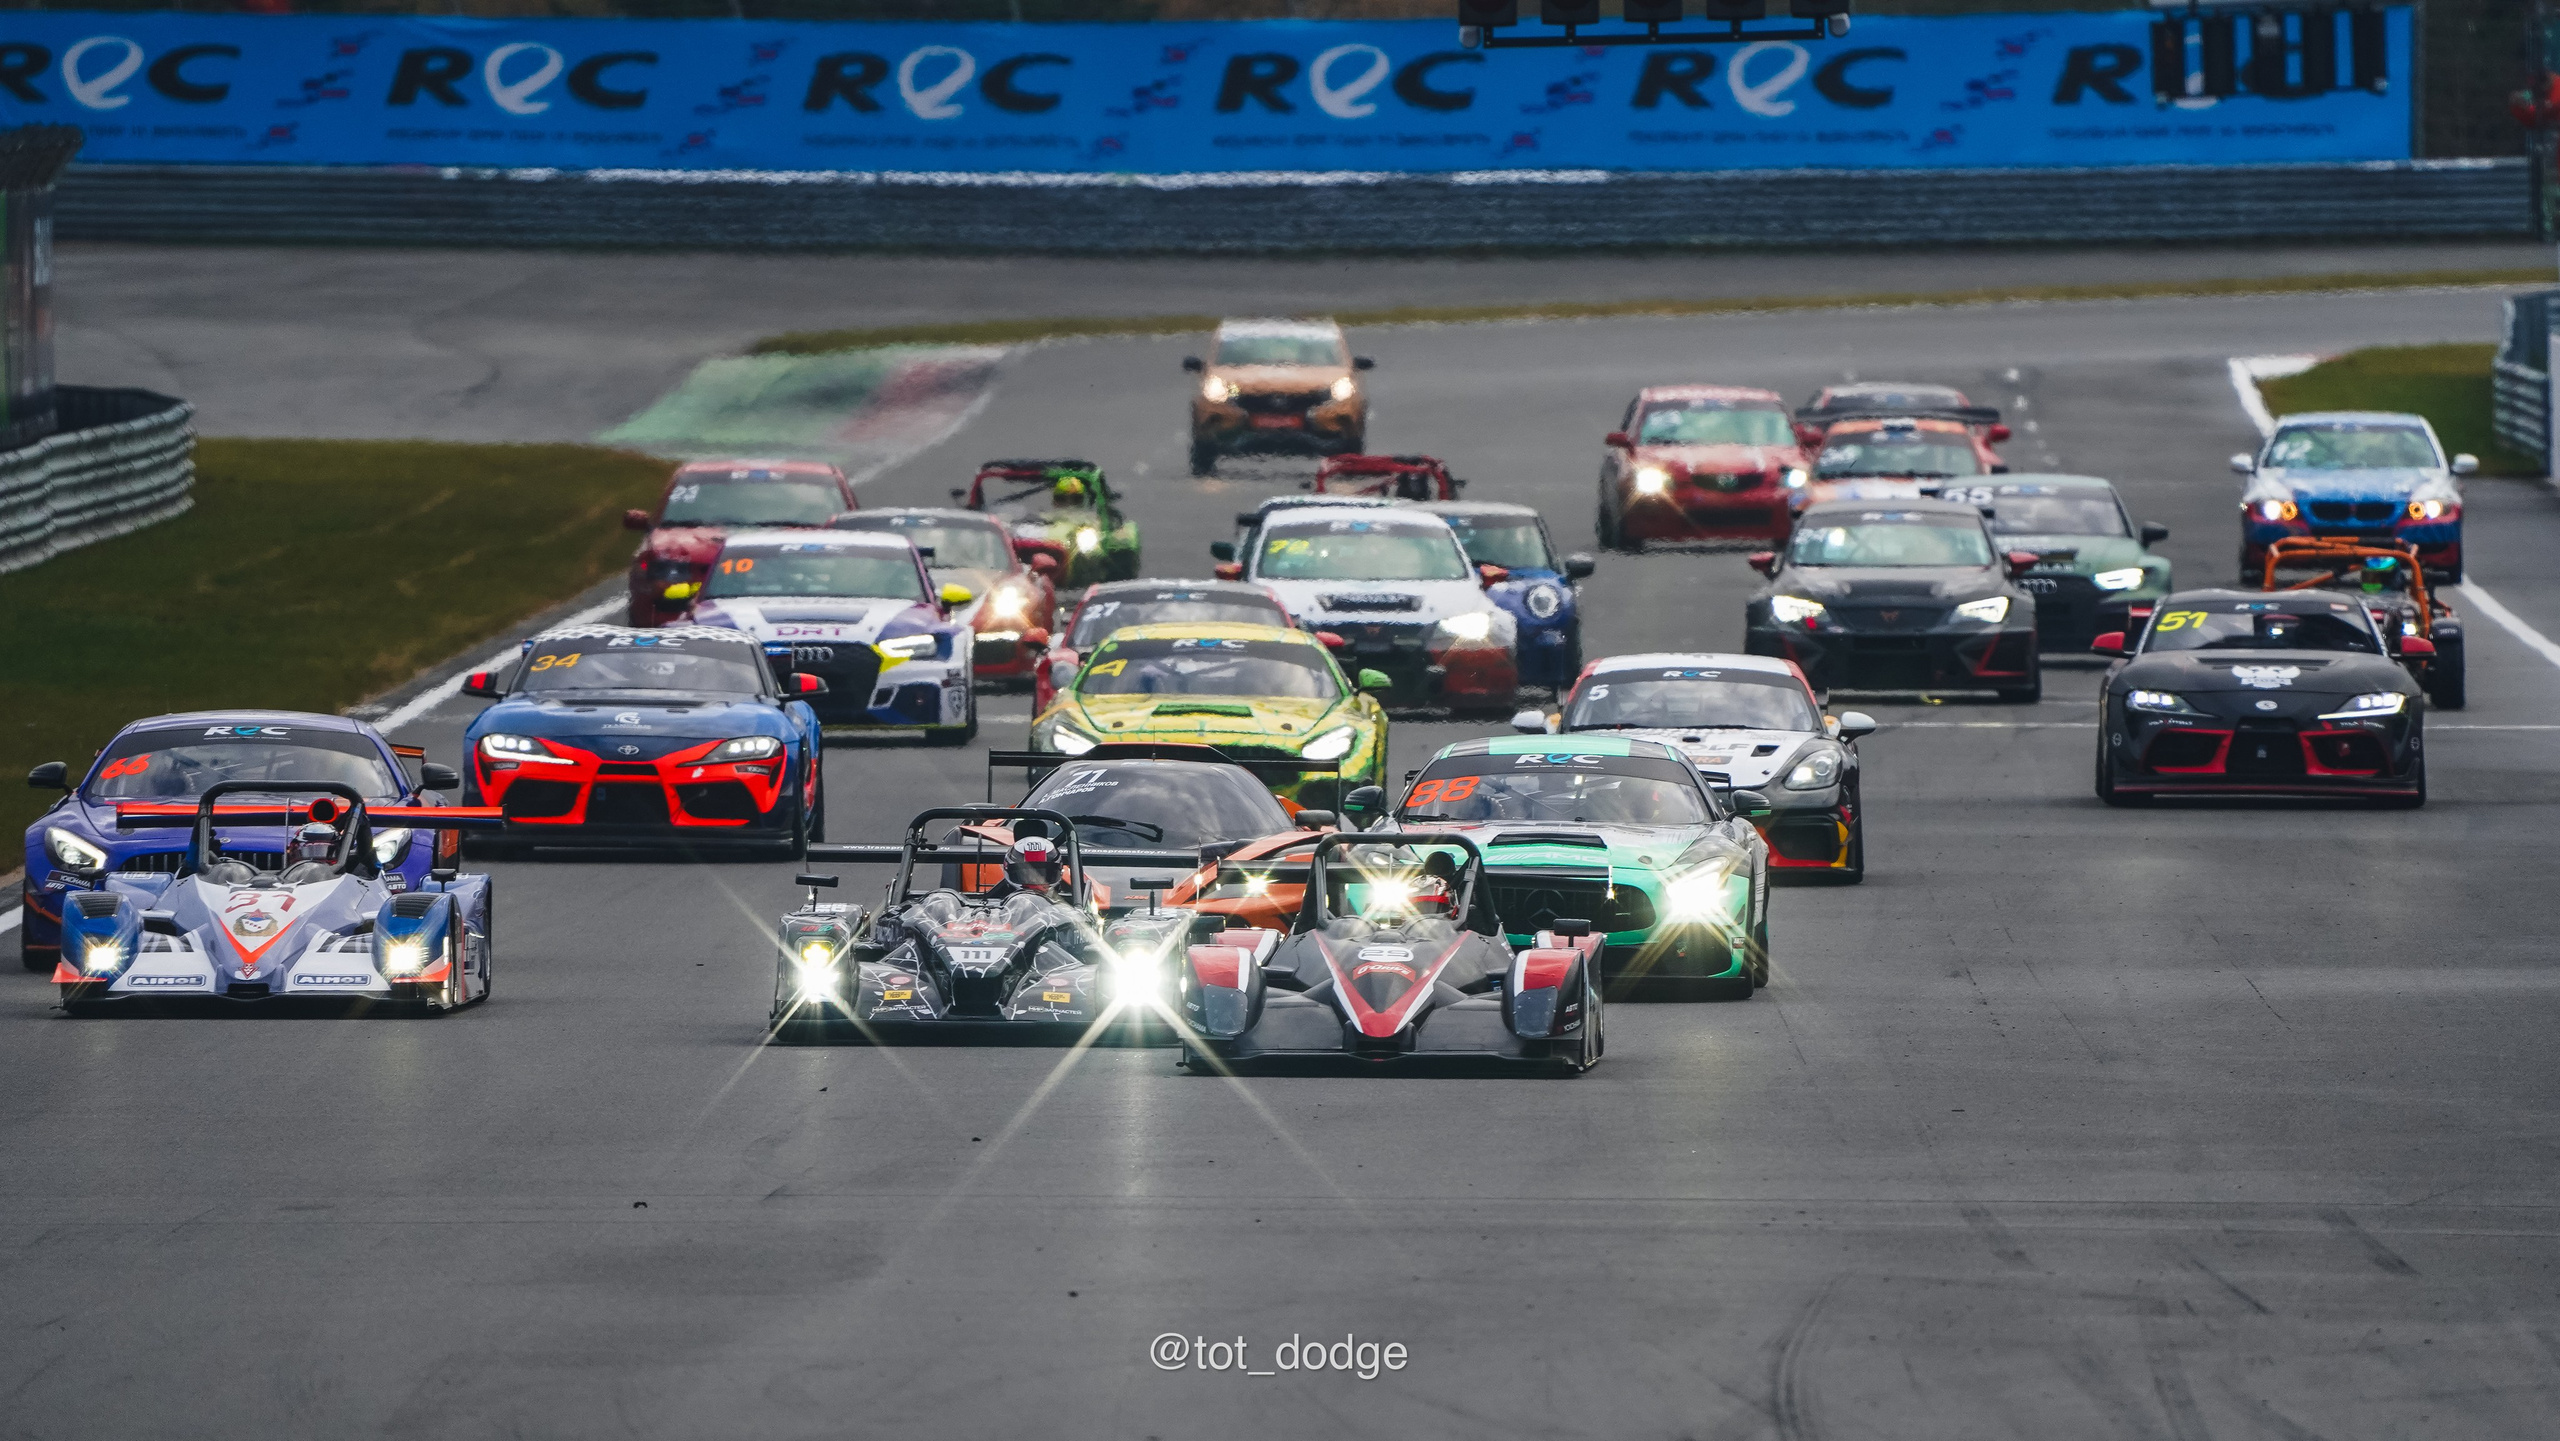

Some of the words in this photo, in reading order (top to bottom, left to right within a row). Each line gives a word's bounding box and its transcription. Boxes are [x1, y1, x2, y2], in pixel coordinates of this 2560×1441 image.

[720, 558, 754, 575] 10
[1082, 601, 1121, 622] 27
[2156, 611, 2208, 632] 51
[531, 653, 582, 672] 34
[1089, 659, 1128, 677] 4
[1588, 684, 1609, 701] 5
[100, 754, 152, 780] 66
[1065, 768, 1108, 789] 71
[1406, 776, 1481, 808] 88
[130, 976, 202, 986] AIMOL
[298, 975, 368, 985] AIMOL
